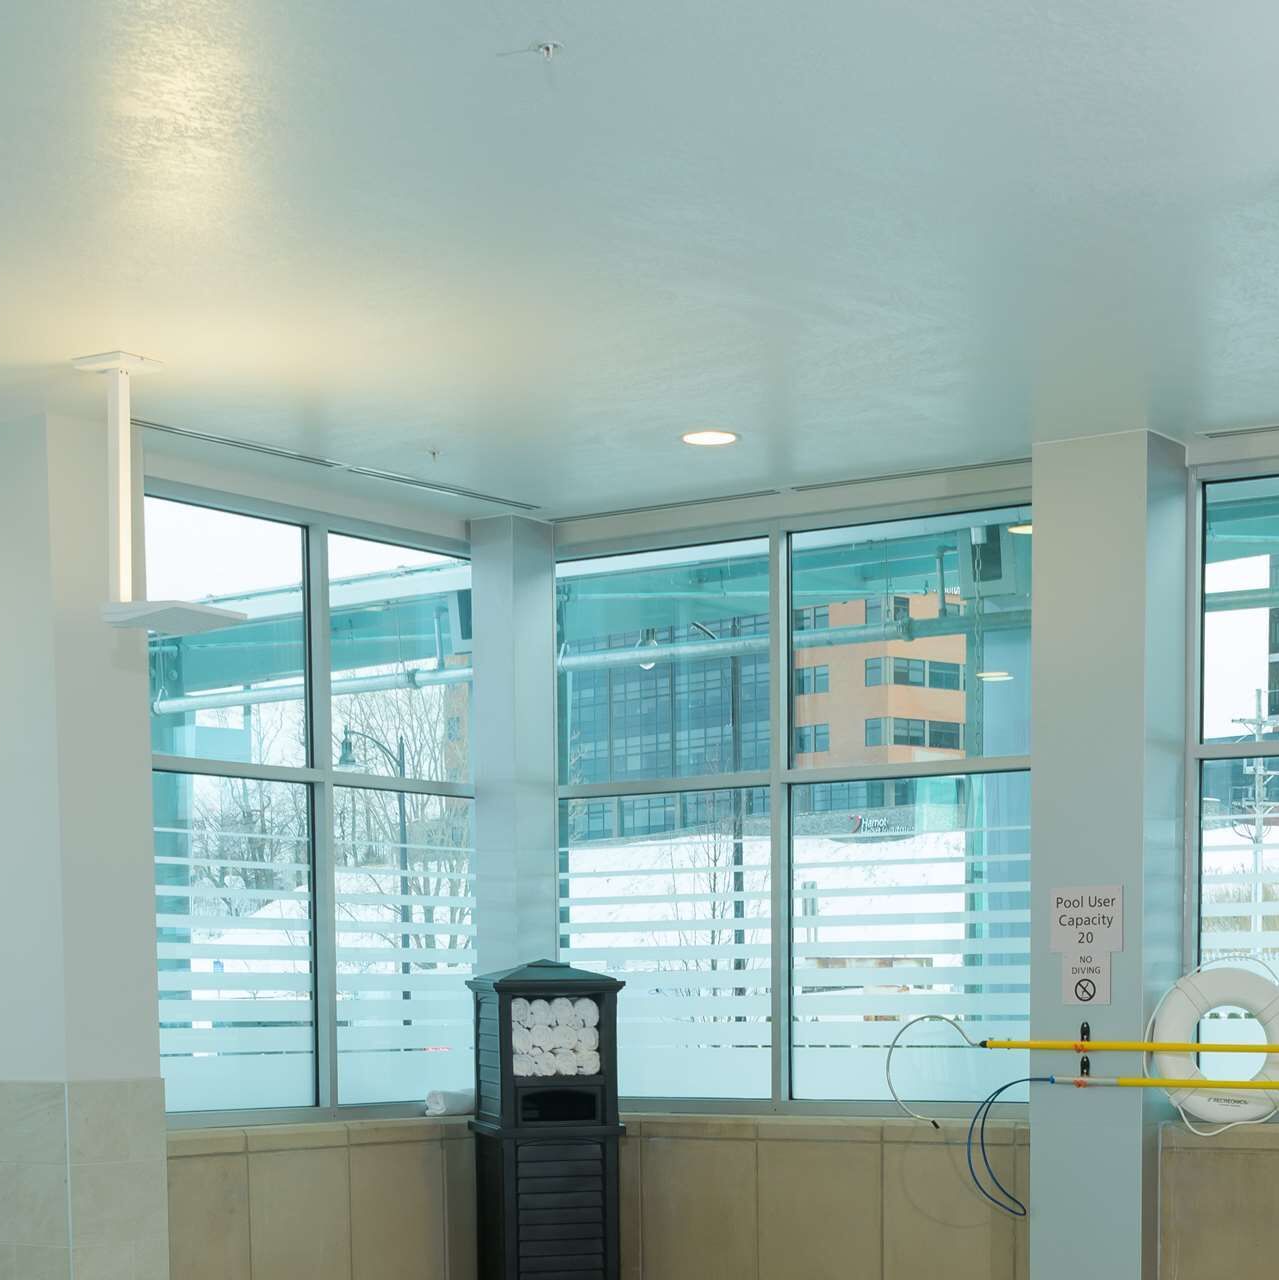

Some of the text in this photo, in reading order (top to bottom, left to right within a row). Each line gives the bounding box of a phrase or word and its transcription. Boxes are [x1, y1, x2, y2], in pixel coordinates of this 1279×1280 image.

[1056, 895, 1116, 909] Pool User
[1058, 913, 1114, 928] Capacity
[1078, 931, 1094, 943] 20
[1080, 955, 1093, 964] NO
[1071, 967, 1101, 975] DIVING
